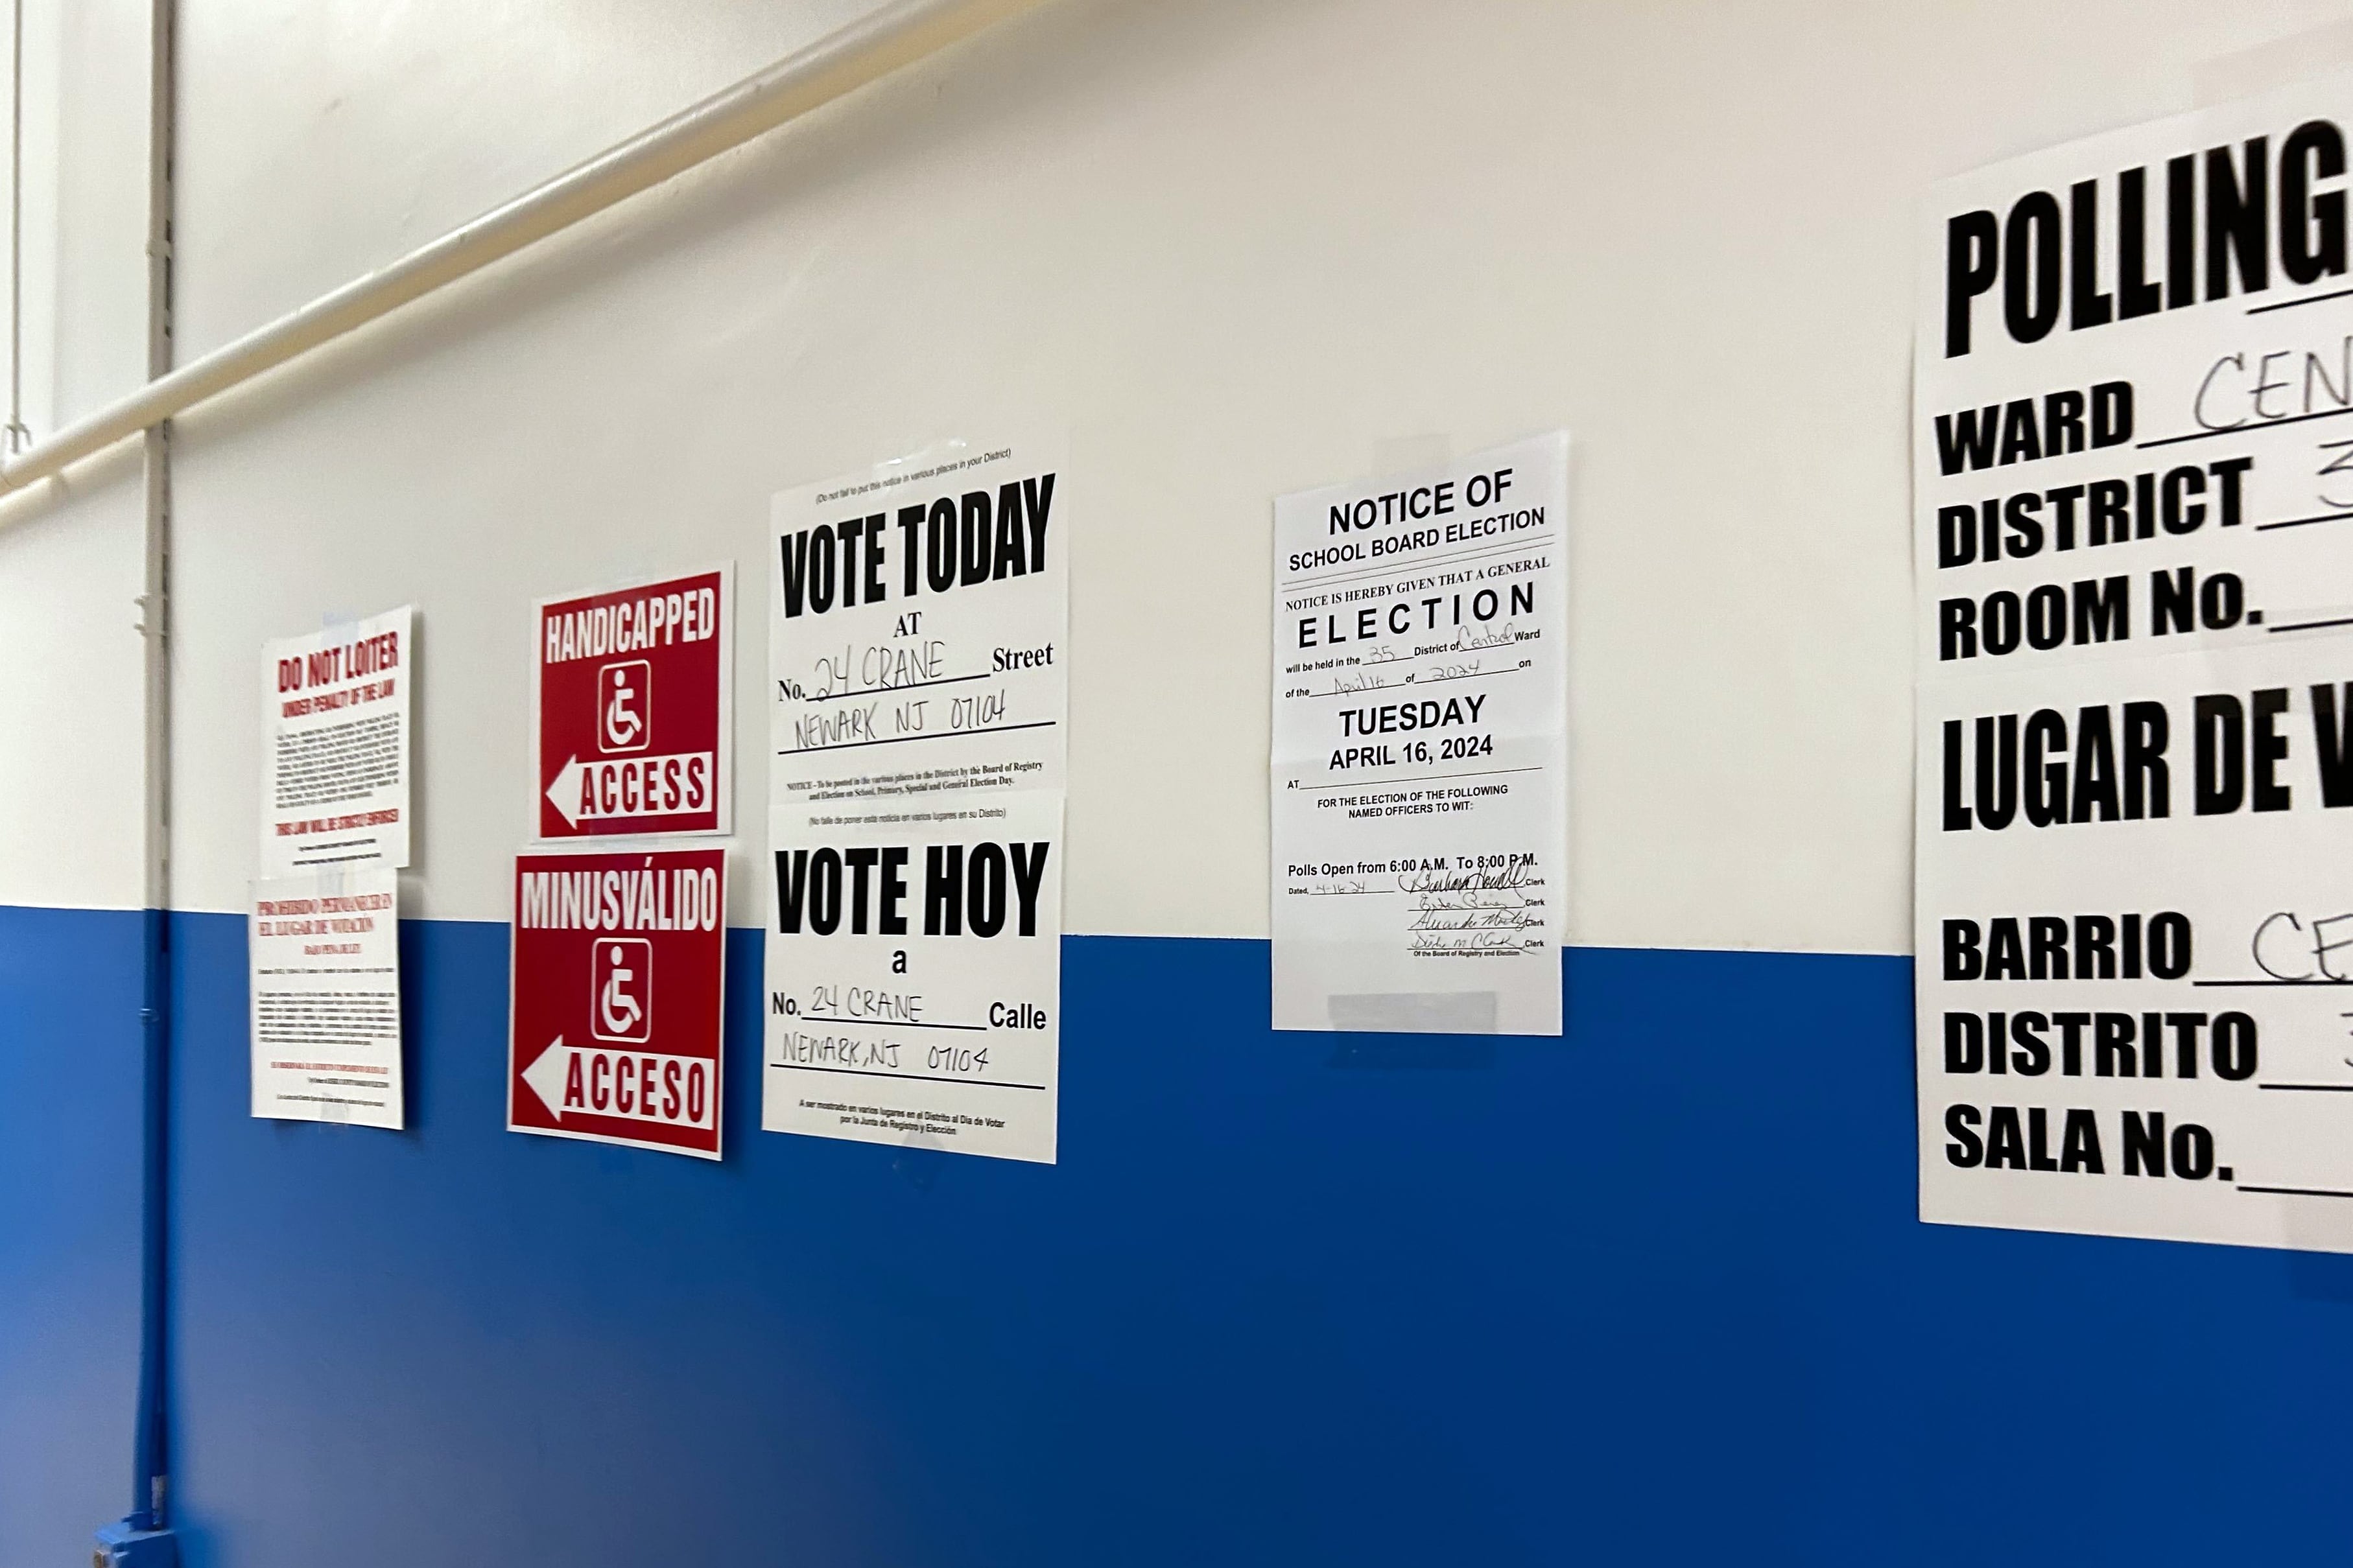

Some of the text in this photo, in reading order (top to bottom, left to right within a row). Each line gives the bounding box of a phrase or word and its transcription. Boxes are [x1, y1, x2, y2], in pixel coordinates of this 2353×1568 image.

[1945, 118, 2348, 359] POLLING
[1935, 380, 2135, 476] WARD
[936, 463, 958, 476] places
[959, 460, 965, 469] in
[967, 456, 982, 469] your
[984, 448, 1011, 463] District)
[1329, 468, 1513, 535] NOTICE OF
[1937, 456, 2253, 569] DISTRICT
[781, 473, 1056, 618] VOTE TODAY
[1288, 506, 1545, 572] SCHOOL BOARD ELECTION
[1285, 557, 1550, 613] NOTICE IS HEREBY GIVEN THAT A GENERAL
[1939, 566, 2264, 661] ROOM No.
[547, 587, 714, 664] HANDICAPPED
[893, 612, 921, 638] AT
[1299, 581, 1533, 648] ELECTION
[278, 631, 399, 693] DO NOT LOITER
[778, 641, 1054, 701] No. 24 CRANE Street
[1285, 688, 1294, 699] of
[1296, 687, 1310, 697] the
[1405, 673, 1415, 685] of
[1430, 659, 1480, 681] 2024
[1518, 659, 1531, 669] on
[1286, 663, 1301, 673] will
[1303, 661, 1313, 672] be
[1315, 658, 1334, 670] held
[1336, 657, 1344, 668] in
[1346, 655, 1361, 666] the
[1369, 645, 1396, 662] 35
[1413, 642, 1448, 657] District
[1450, 640, 1460, 651] of
[1515, 629, 1541, 642] Ward
[796, 689, 1005, 749] NEWARK NJ 07104
[1338, 694, 1486, 737] TUESDAY
[935, 769, 959, 778] District
[970, 766, 980, 775] the
[982, 764, 1003, 774] Board
[1005, 763, 1012, 771] of
[1014, 762, 1043, 771] Registry
[1329, 734, 1493, 770] APRIL 16, 2024
[1943, 699, 2170, 832] LUGAR
[2192, 688, 2291, 816] DE
[580, 756, 705, 815] ACCESS
[943, 779, 968, 789] General
[970, 778, 997, 787] Election
[999, 777, 1014, 786] Day.
[1287, 779, 1299, 790] AT
[1318, 784, 1508, 808] FOR THE ELECTION OF THE FOLLOWING
[1349, 801, 1474, 819] NAMED OFFICERS TO WIT:
[979, 808, 1006, 819] Distrito)
[521, 856, 717, 931] MINUSVÁLIDO
[774, 842, 1050, 939] VOTE HOY
[1288, 852, 1537, 878] Polls Open from 6:00 A.M. To 8:00 P.M.
[1288, 887, 1308, 895] Dated,
[892, 950, 907, 974] a
[1943, 910, 2192, 981] BARRIO
[773, 985, 1046, 1030] No. 24 CRANE Calle
[928, 1046, 989, 1072] 07104
[1943, 1011, 2258, 1082] DISTRITO
[564, 1052, 705, 1123] ACCESO
[840, 1116, 851, 1125] por
[880, 1119, 888, 1127] de
[890, 1119, 918, 1131] Registro
[920, 1124, 925, 1134] y
[880, 1107, 905, 1118] lugares
[925, 1111, 950, 1122] Distrito
[952, 1114, 958, 1123] al
[974, 1117, 983, 1125] de
[985, 1117, 1005, 1128] Votar
[1945, 1104, 2234, 1182] SALA No.
